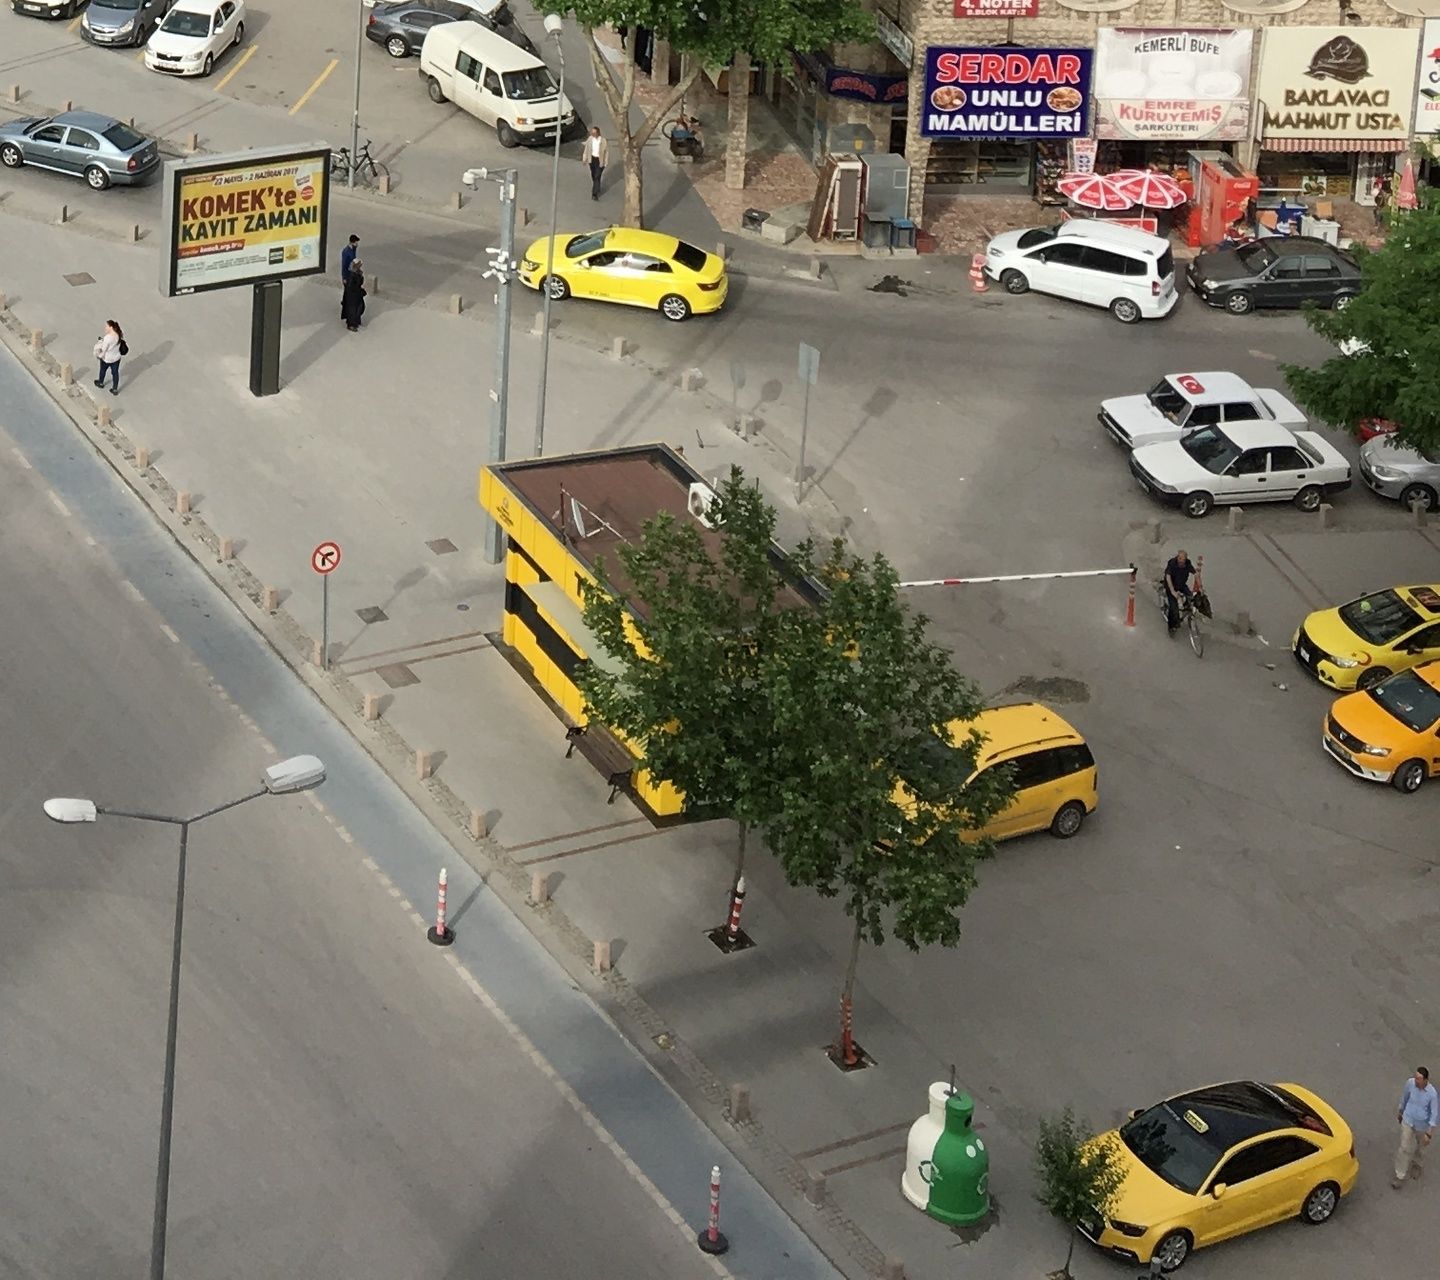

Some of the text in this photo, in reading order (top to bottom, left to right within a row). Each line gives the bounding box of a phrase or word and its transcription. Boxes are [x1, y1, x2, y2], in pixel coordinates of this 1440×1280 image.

[1134, 34, 1220, 55] KEMERLİ BÜFE
[936, 53, 1082, 84] SERDAR
[971, 90, 1043, 107] UNLU
[1144, 101, 1197, 110] EMRE
[1284, 89, 1390, 107] BAKLAVACI
[928, 111, 1082, 132] MAMÜLLERİ
[1119, 103, 1222, 124] KURUYEMİŞ
[1264, 112, 1405, 130] MAHMUT USTA
[181, 205, 318, 243] KAYIT ZAMANI
